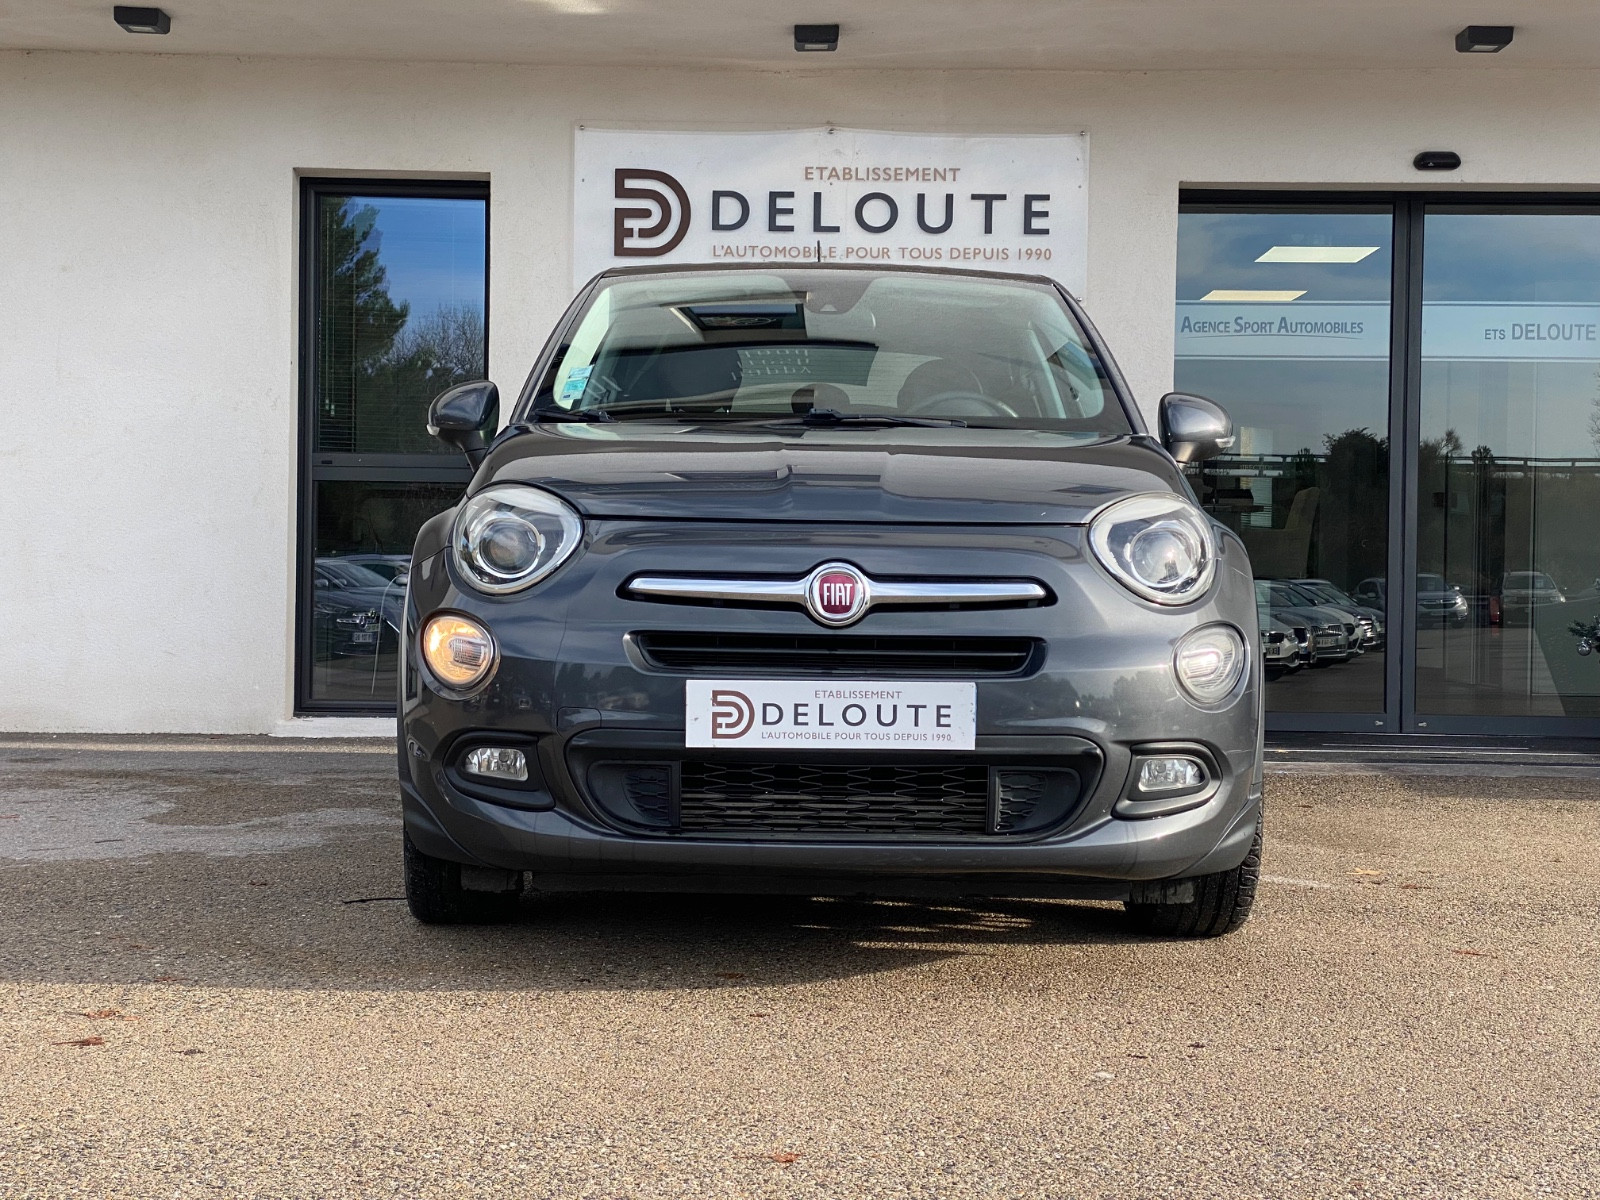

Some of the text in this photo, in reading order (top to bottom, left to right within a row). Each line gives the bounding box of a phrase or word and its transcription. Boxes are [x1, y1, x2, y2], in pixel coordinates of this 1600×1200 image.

[804, 166, 961, 183] ETABLISSEMENT
[711, 190, 1051, 236] DELOUTE
[845, 247, 891, 261] POUR
[898, 247, 943, 261] TOUS
[950, 247, 1009, 262] DEPUIS
[1018, 247, 1053, 262] 1990
[1484, 323, 1597, 341] ETS DELOUTE
[823, 582, 853, 606] FIAT
[814, 690, 903, 700] ETABLISSEMENT
[762, 702, 952, 728] DELOUTE
[761, 731, 952, 743] L'AUTOMOBILE POUR TOUS DEPUIS 1990
